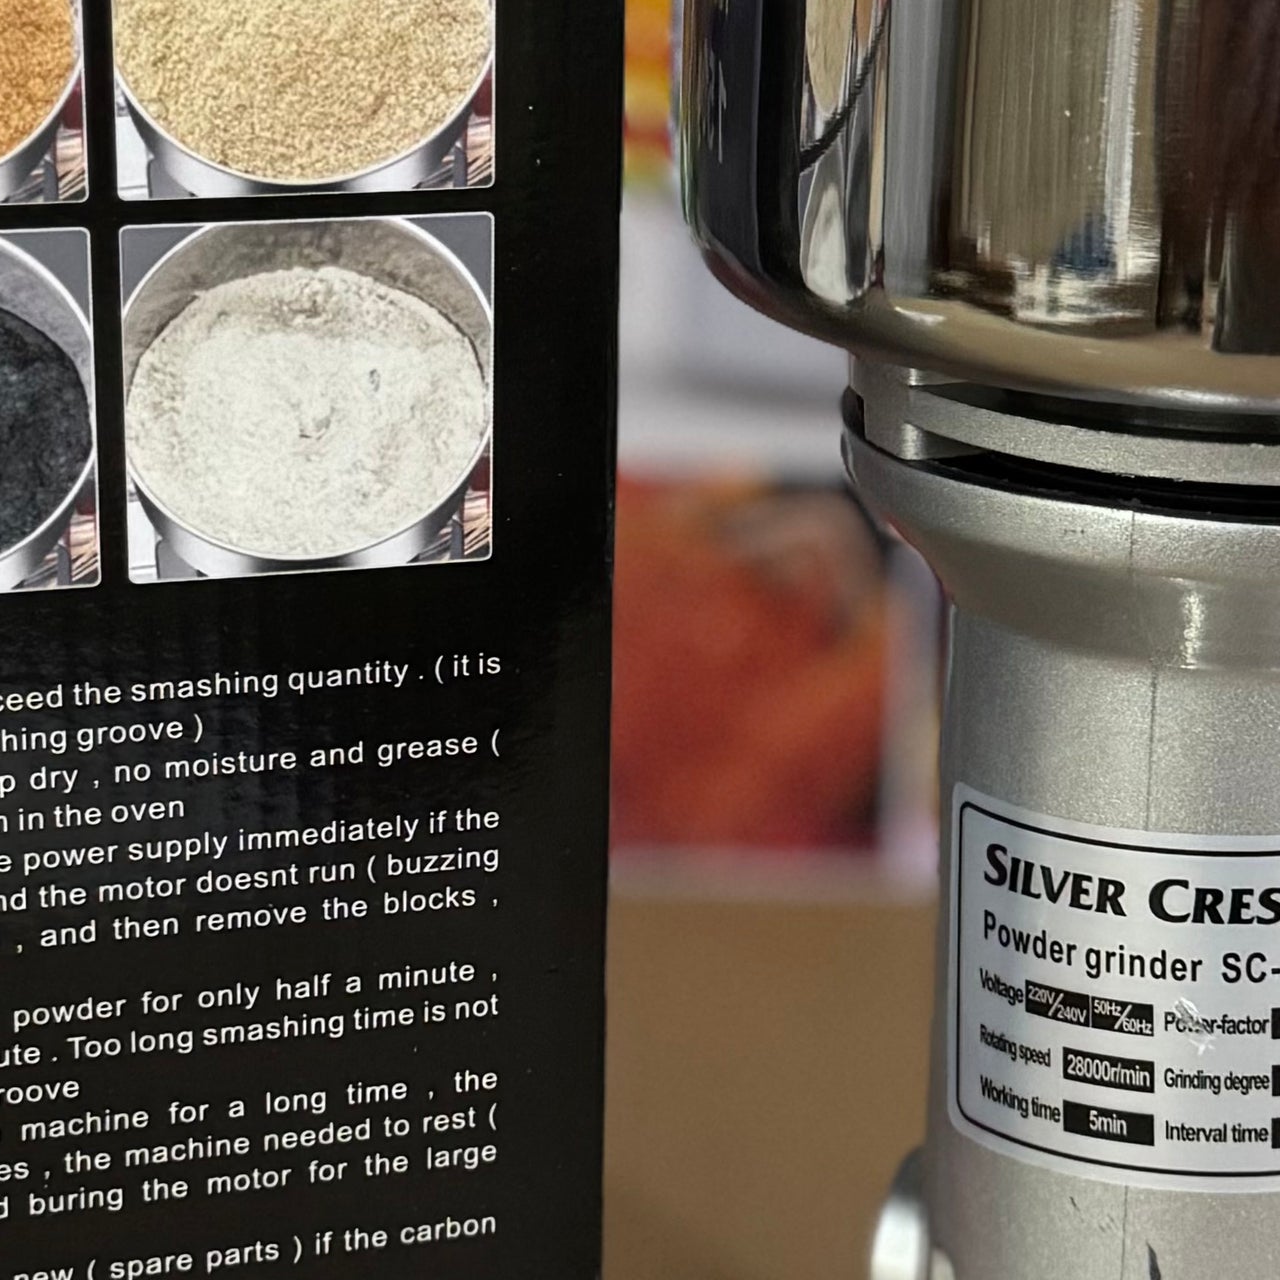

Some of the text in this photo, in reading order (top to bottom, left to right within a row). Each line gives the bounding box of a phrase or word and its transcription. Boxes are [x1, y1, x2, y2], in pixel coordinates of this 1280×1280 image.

[76, 720, 184, 753] groove
[17, 807, 45, 832] in
[52, 803, 103, 829] the
[110, 799, 185, 823] oven
[38, 883, 87, 909] the
[98, 875, 187, 903] motor
[195, 863, 299, 894] doesnt
[308, 862, 356, 885] run
[387, 846, 500, 877] buzzing
[983, 843, 1128, 917] SILVER
[983, 909, 1077, 967] Powder
[1085, 945, 1203, 982] grinder
[979, 967, 1024, 1006] Voltage
[980, 1023, 1151, 1087] Rotating speed 28000r/min
[1164, 1068, 1221, 1095] Grinding
[1223, 1071, 1270, 1095] degree
[979, 1074, 1128, 1137] Working time 5min
[1165, 1120, 1227, 1143] Interval
[1232, 1123, 1269, 1142] time
[28, 1186, 124, 1216] buring
[141, 1177, 189, 1203] the
[206, 1167, 293, 1196] motor
[307, 1159, 349, 1184] for
[363, 1152, 409, 1177] the
[426, 1144, 498, 1171] large
